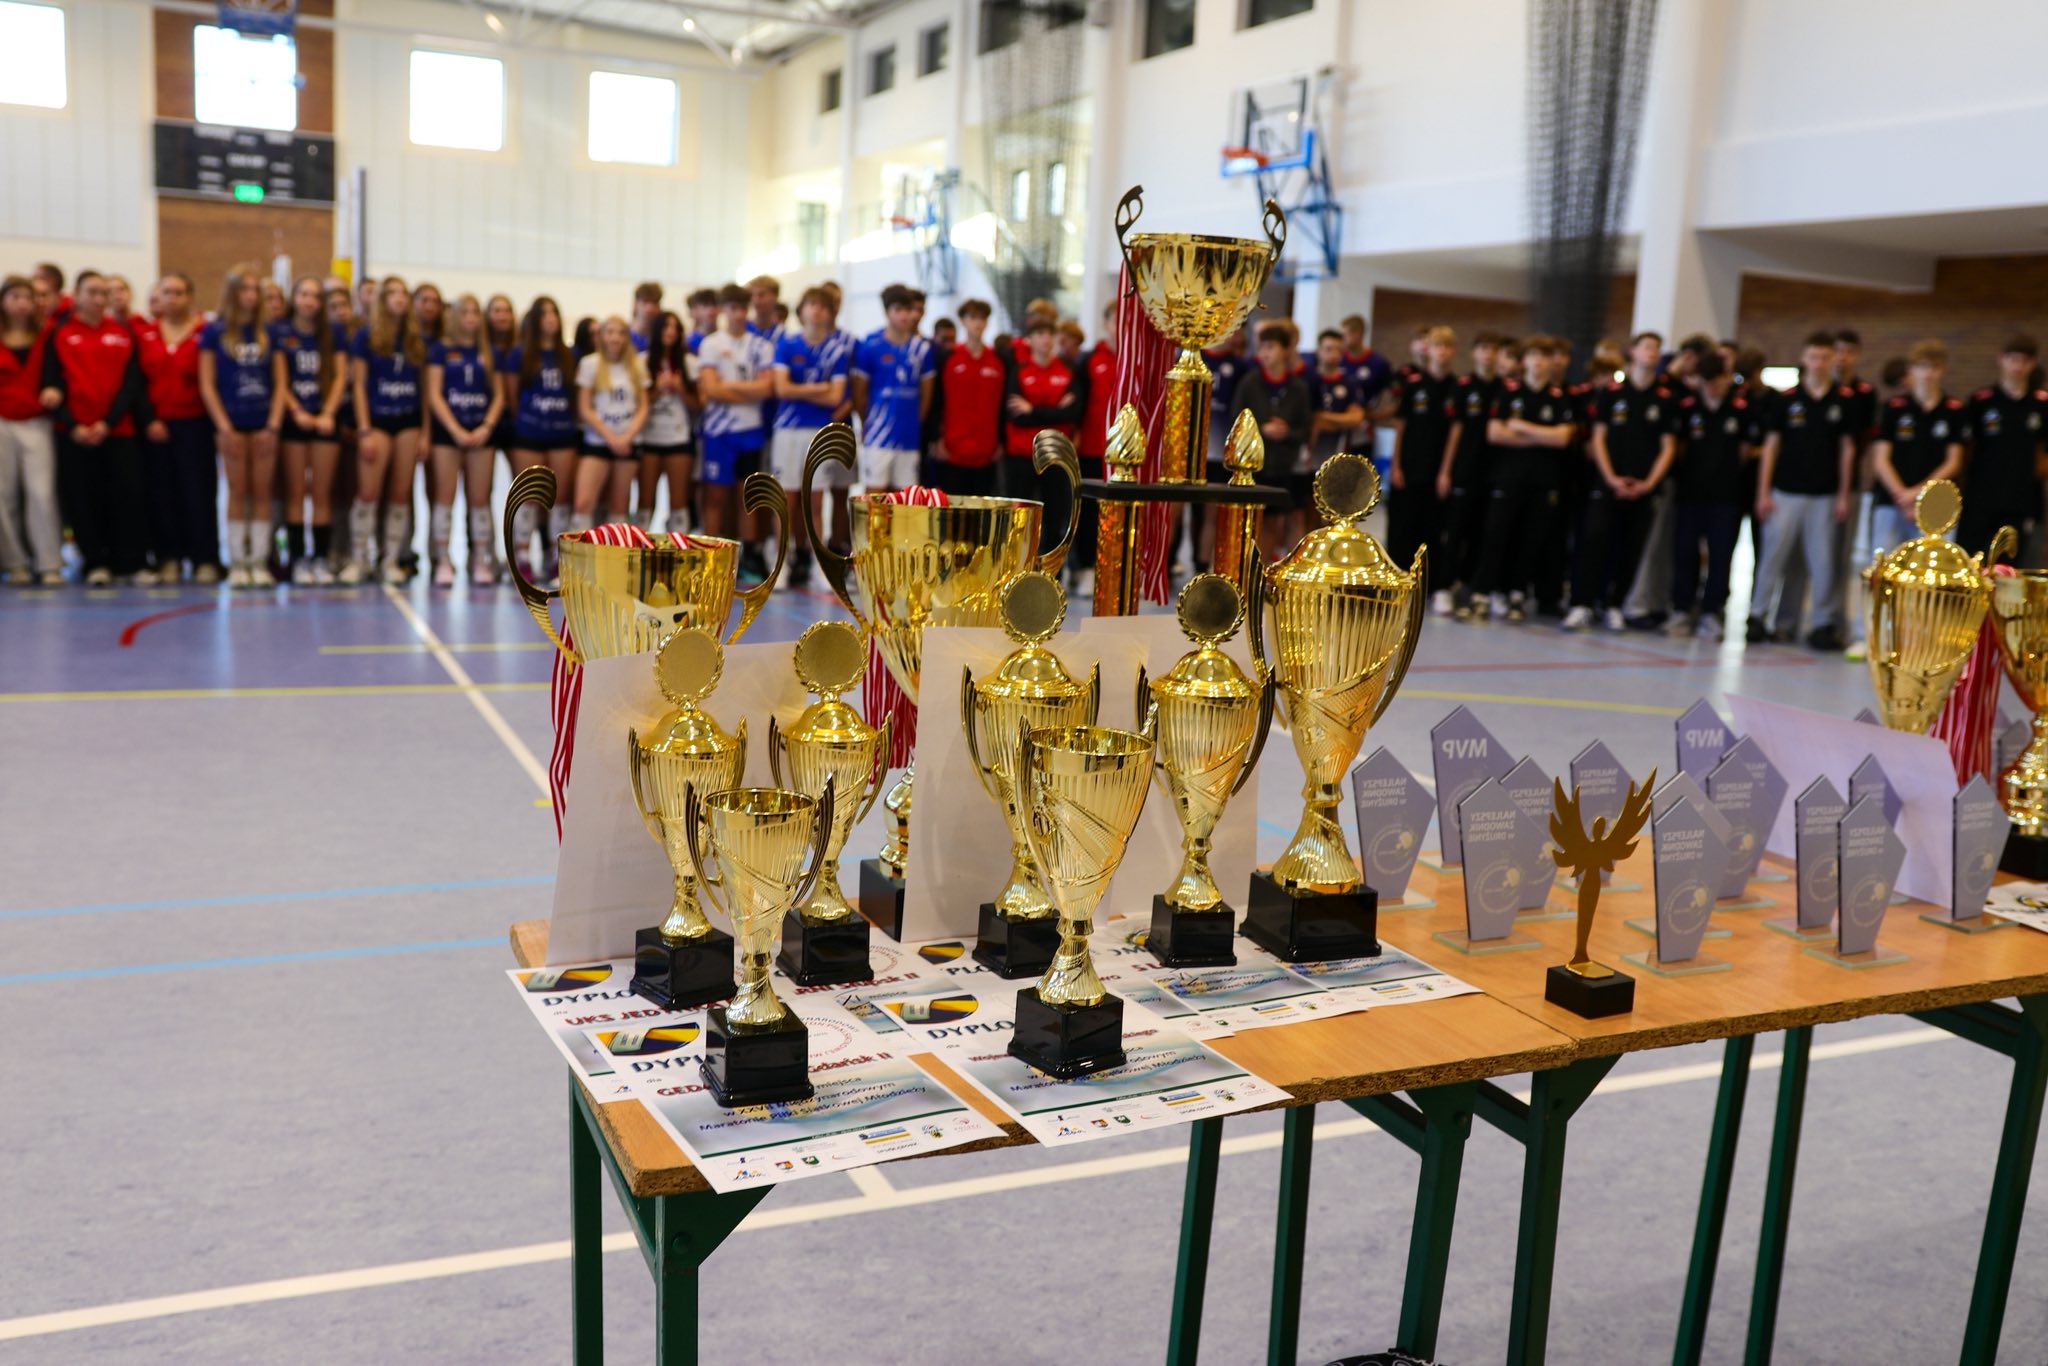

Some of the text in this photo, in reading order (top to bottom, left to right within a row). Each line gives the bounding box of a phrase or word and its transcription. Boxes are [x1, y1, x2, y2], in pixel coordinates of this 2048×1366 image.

[542, 988, 635, 1007] DYPLO
[565, 1013, 615, 1026] UKS
[927, 1020, 1015, 1039] DYPLO
[879, 1051, 894, 1062] II
[816, 1076, 862, 1090] miejsca
[699, 1115, 767, 1132] Maratonie
[799, 1096, 864, 1116] Siatkowej
[864, 1085, 928, 1107] Młodzieży
